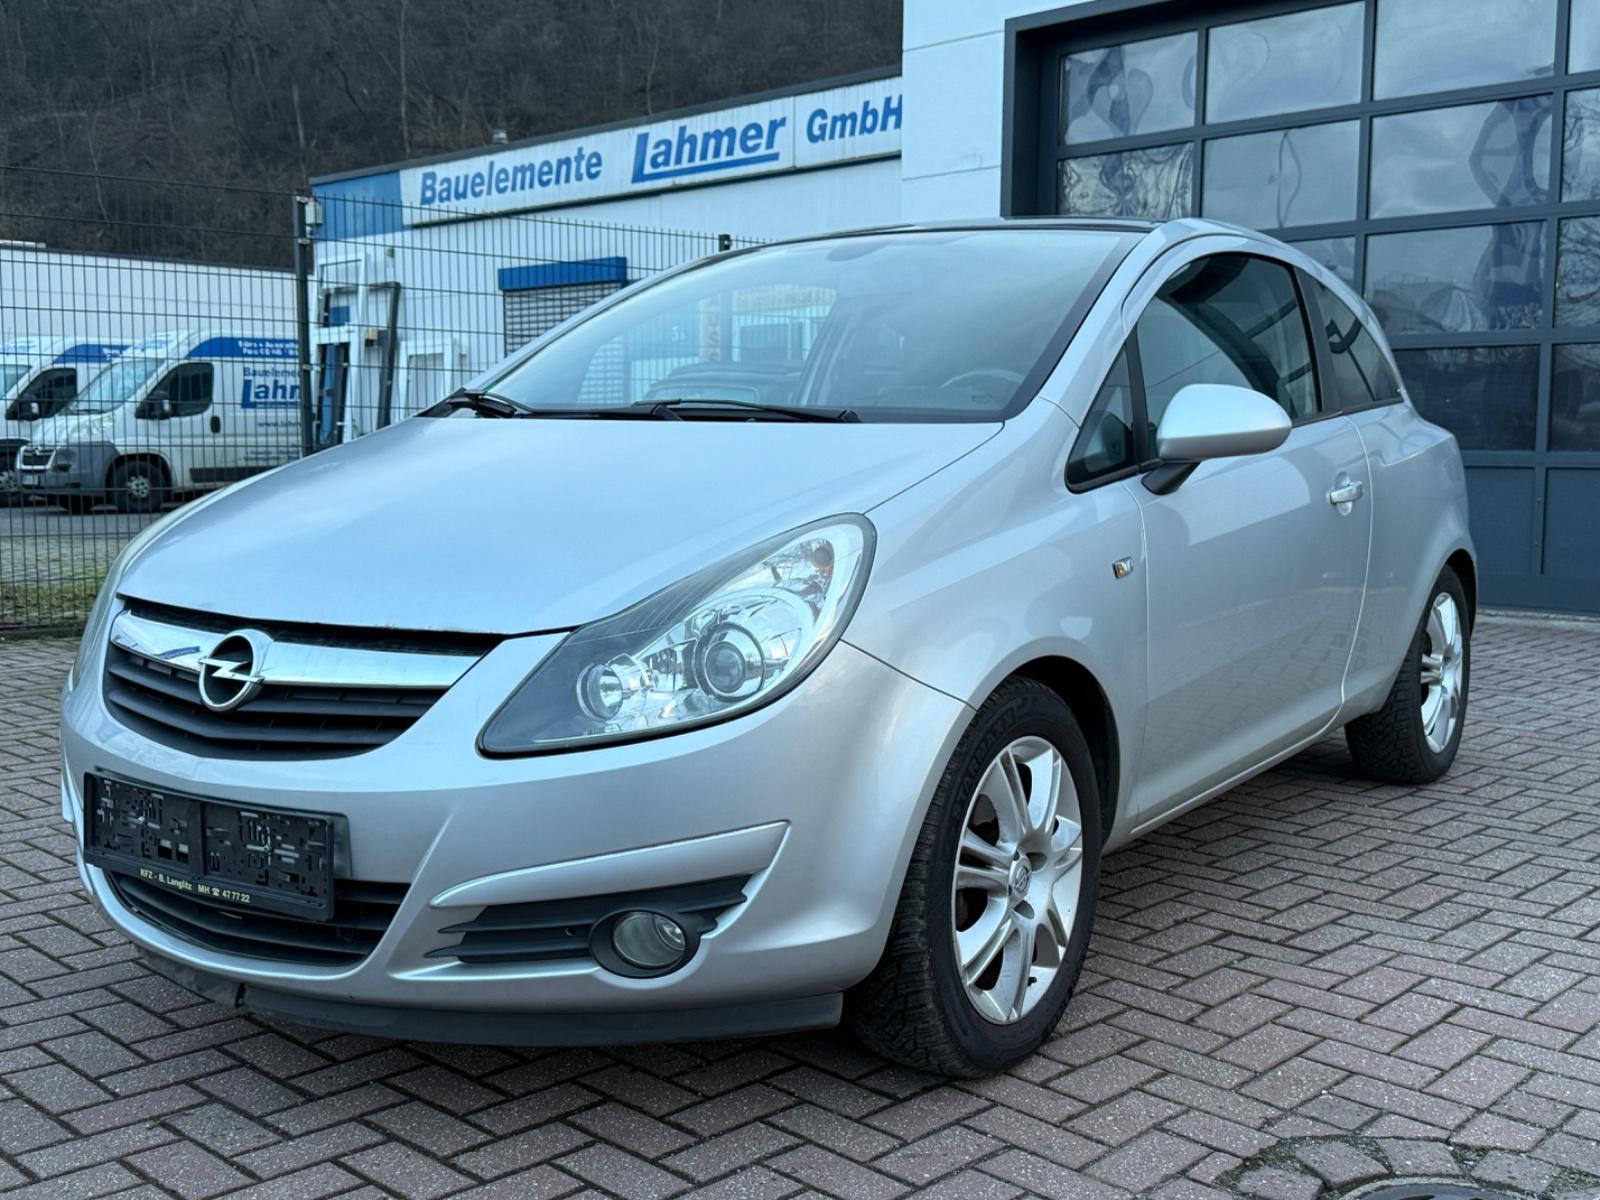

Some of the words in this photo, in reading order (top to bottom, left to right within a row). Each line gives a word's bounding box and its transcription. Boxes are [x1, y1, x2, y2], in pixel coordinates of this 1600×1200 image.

[420, 146, 603, 206] Bauelemente
[631, 116, 787, 183] Lahmer
[806, 94, 903, 143] GmbH
[140, 868, 153, 879] KFZ
[198, 884, 210, 895] MH
